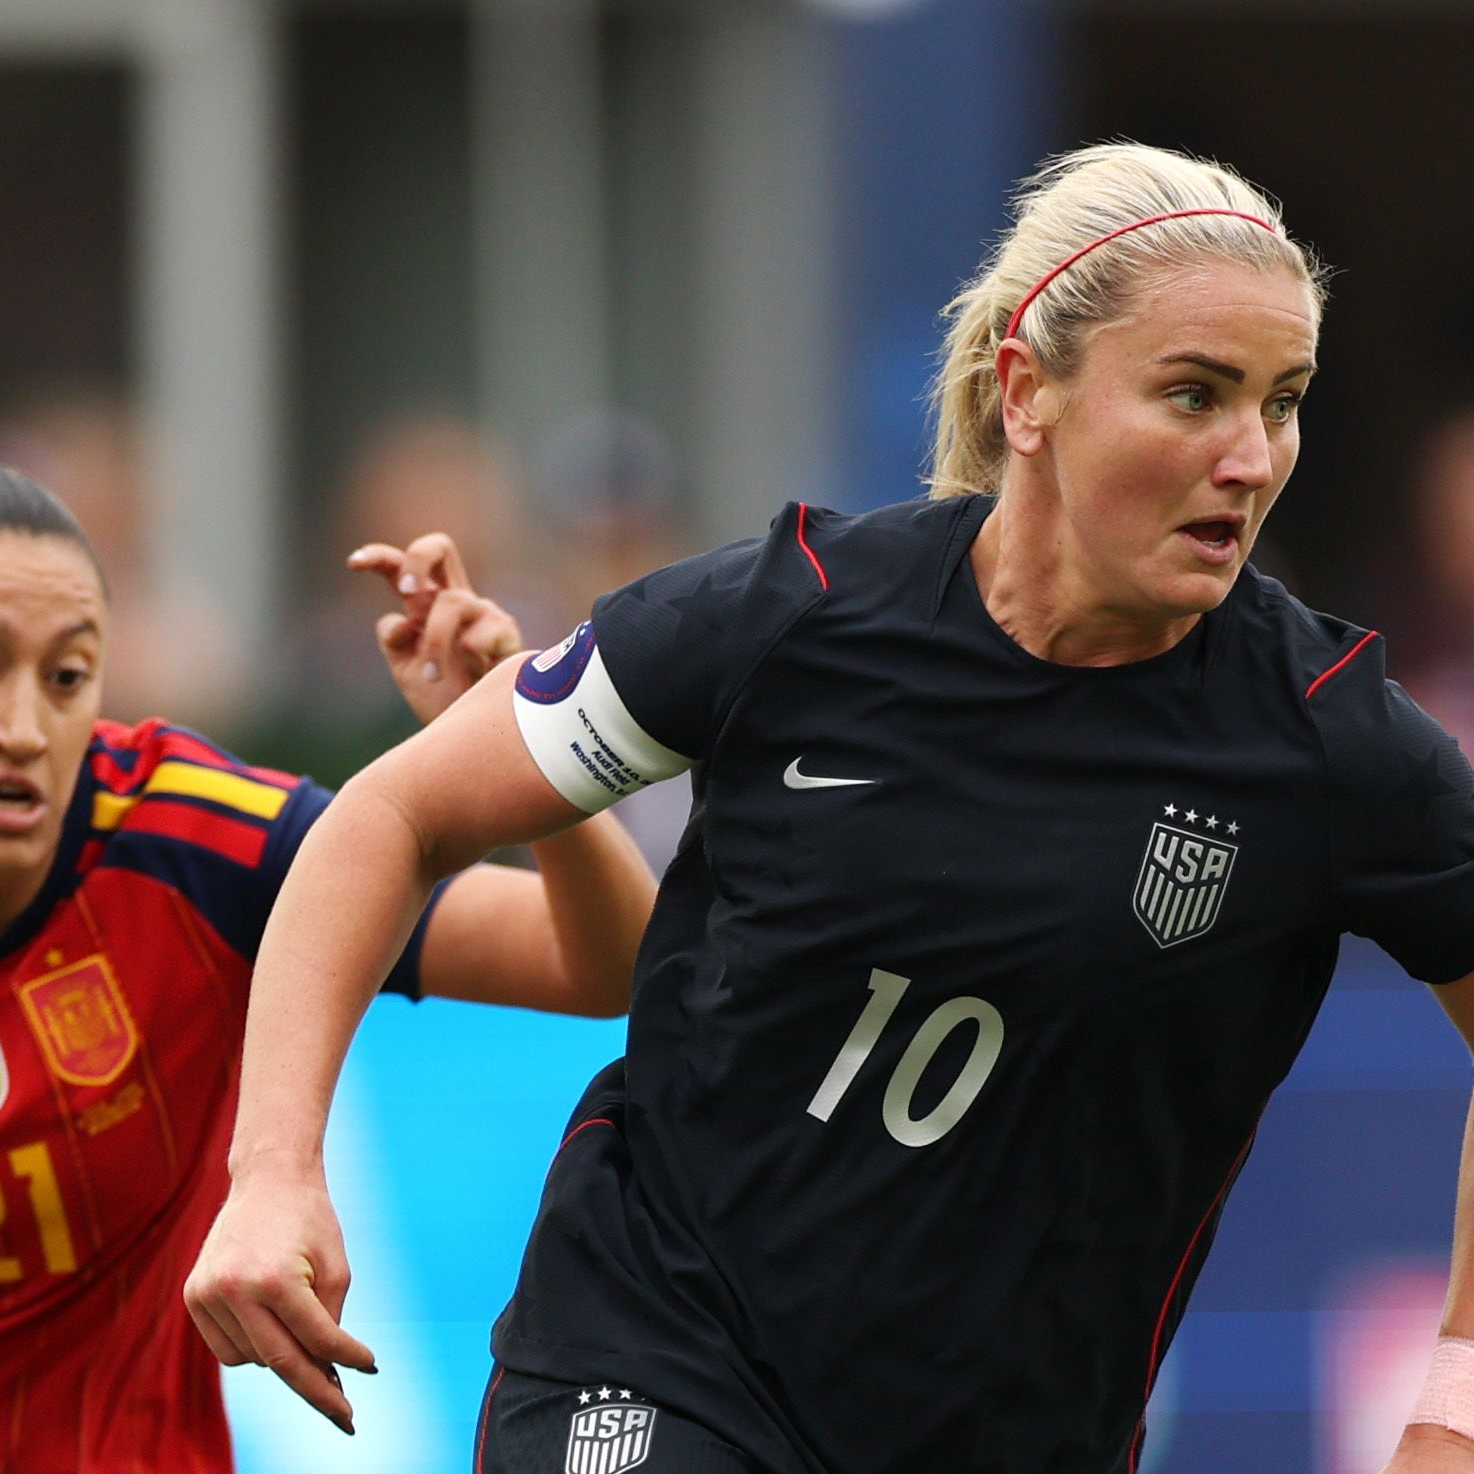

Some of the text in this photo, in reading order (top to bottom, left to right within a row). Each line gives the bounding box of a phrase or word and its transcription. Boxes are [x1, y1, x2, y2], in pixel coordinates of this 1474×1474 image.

[577, 707, 625, 768] OCTOBER
[591, 750, 615, 771] Audi
[1153, 831, 1230, 884] USA
[806, 967, 1005, 1148] 10
[576, 1408, 649, 1439] USA
